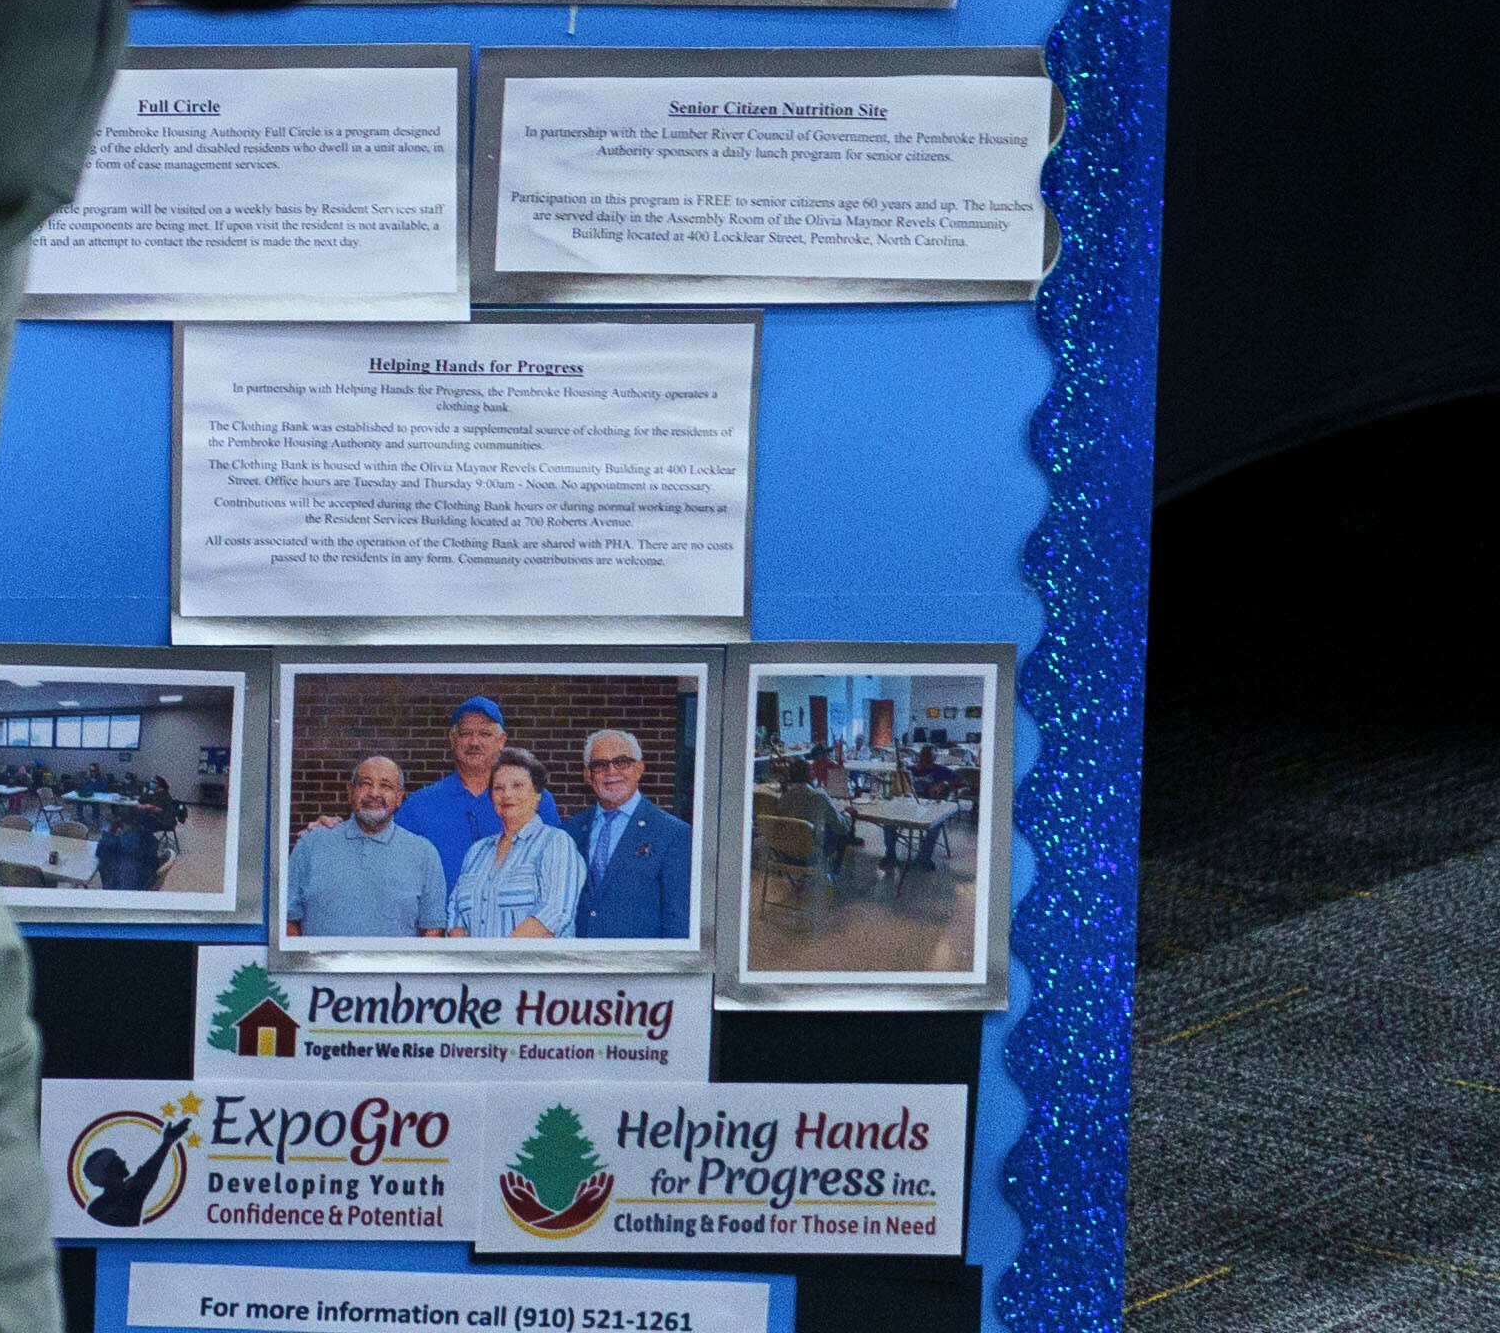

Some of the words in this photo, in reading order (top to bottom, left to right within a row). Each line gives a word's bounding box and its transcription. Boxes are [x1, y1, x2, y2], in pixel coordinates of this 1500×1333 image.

[138, 99, 170, 113] Full
[173, 99, 221, 113] Circle
[668, 101, 719, 115] Senior
[723, 101, 777, 116] Citizen
[783, 102, 853, 117] Nutrition
[857, 103, 888, 118] Site
[106, 125, 159, 137] Pembroke
[161, 125, 207, 140] Housing
[208, 125, 261, 140] Authority
[263, 125, 286, 137] Full
[287, 125, 321, 137] Circle
[323, 126, 333, 137] is
[335, 128, 342, 137] a
[344, 128, 390, 140] program
[392, 124, 440, 140] designed
[524, 125, 538, 137] In
[540, 125, 607, 141] partnership
[609, 126, 637, 139] with
[639, 127, 658, 139] the
[660, 127, 708, 140] Lumber
[710, 128, 744, 141] River
[746, 128, 794, 142] Council
[796, 129, 810, 142] of
[812, 130, 891, 145] Government,
[893, 131, 913, 144] the
[915, 131, 976, 145] Pembroke
[978, 132, 1028, 148] Housing
[596, 142, 654, 159] Authority
[655, 147, 709, 160] sponsors
[711, 148, 719, 157] a
[721, 145, 752, 161] daily
[754, 145, 788, 158] lunch
[790, 150, 842, 162] program
[844, 147, 863, 160] for
[865, 149, 902, 161] senior
[904, 149, 952, 161] citizens.
[510, 191, 588, 207] Participation
[589, 193, 602, 204] in
[603, 192, 627, 205] this
[629, 196, 680, 209] program
[682, 195, 694, 206] is
[696, 194, 732, 207] FREE
[734, 196, 747, 207] to
[749, 196, 787, 207] senior
[789, 196, 835, 208] citizens
[837, 199, 859, 212] age
[861, 196, 878, 209] 60
[880, 200, 912, 212] years
[913, 197, 937, 210] and
[939, 201, 959, 213] up.
[961, 198, 986, 211] The
[988, 198, 1032, 211] lunches
[532, 212, 552, 221] are
[554, 209, 594, 222] served
[596, 209, 627, 225] daily
[629, 211, 642, 223] in
[644, 210, 663, 223] the
[665, 211, 725, 227] Assembly
[727, 212, 765, 225] Room
[767, 213, 781, 225] of
[783, 213, 802, 226] the
[804, 213, 843, 226] Olivia
[845, 214, 893, 230] Maynor
[895, 215, 936, 228] Revels
[938, 216, 1010, 232] Community
[572, 226, 624, 243] Building
[626, 227, 670, 241] located
[672, 230, 684, 241] at
[686, 229, 710, 241] 400
[712, 229, 765, 243] Locklear
[767, 230, 806, 245] Street,
[808, 231, 873, 246] Pembroke,
[875, 233, 911, 246] North
[913, 234, 968, 247] Carolina.
[369, 357, 431, 374] Helping
[435, 359, 485, 373] Hands
[489, 359, 511, 373] for
[518, 360, 584, 376] Progress
[307, 981, 502, 1029] Pembroke
[515, 990, 674, 1040] Housing
[304, 1041, 375, 1060] Together
[375, 1043, 400, 1058] We
[402, 1042, 434, 1058] Rise
[440, 1043, 508, 1062] Diversity
[519, 1044, 595, 1060] Education
[606, 1045, 669, 1064] Housing
[211, 1096, 450, 1166] ExpoGro
[616, 1106, 779, 1163] Helping
[794, 1106, 930, 1151] Hands
[208, 1172, 360, 1200] Developing
[369, 1174, 445, 1196] Youth
[650, 1167, 691, 1196] for
[697, 1156, 886, 1209] Progress
[892, 1172, 937, 1197] inc.
[207, 1203, 324, 1225] Confidence
[329, 1205, 343, 1225] &
[348, 1205, 443, 1227] Potential
[613, 1213, 697, 1237] Clothing
[700, 1215, 715, 1233] &
[718, 1214, 766, 1234] Food
[770, 1214, 797, 1234] for
[801, 1215, 859, 1234] Those
[863, 1216, 881, 1234] in
[886, 1216, 937, 1236] Need
[200, 1296, 240, 1317] For
[246, 1302, 310, 1321] more
[316, 1299, 460, 1326] information
[466, 1304, 508, 1327] call
[513, 1304, 576, 1331] (910)
[581, 1307, 695, 1331] 521-1261
